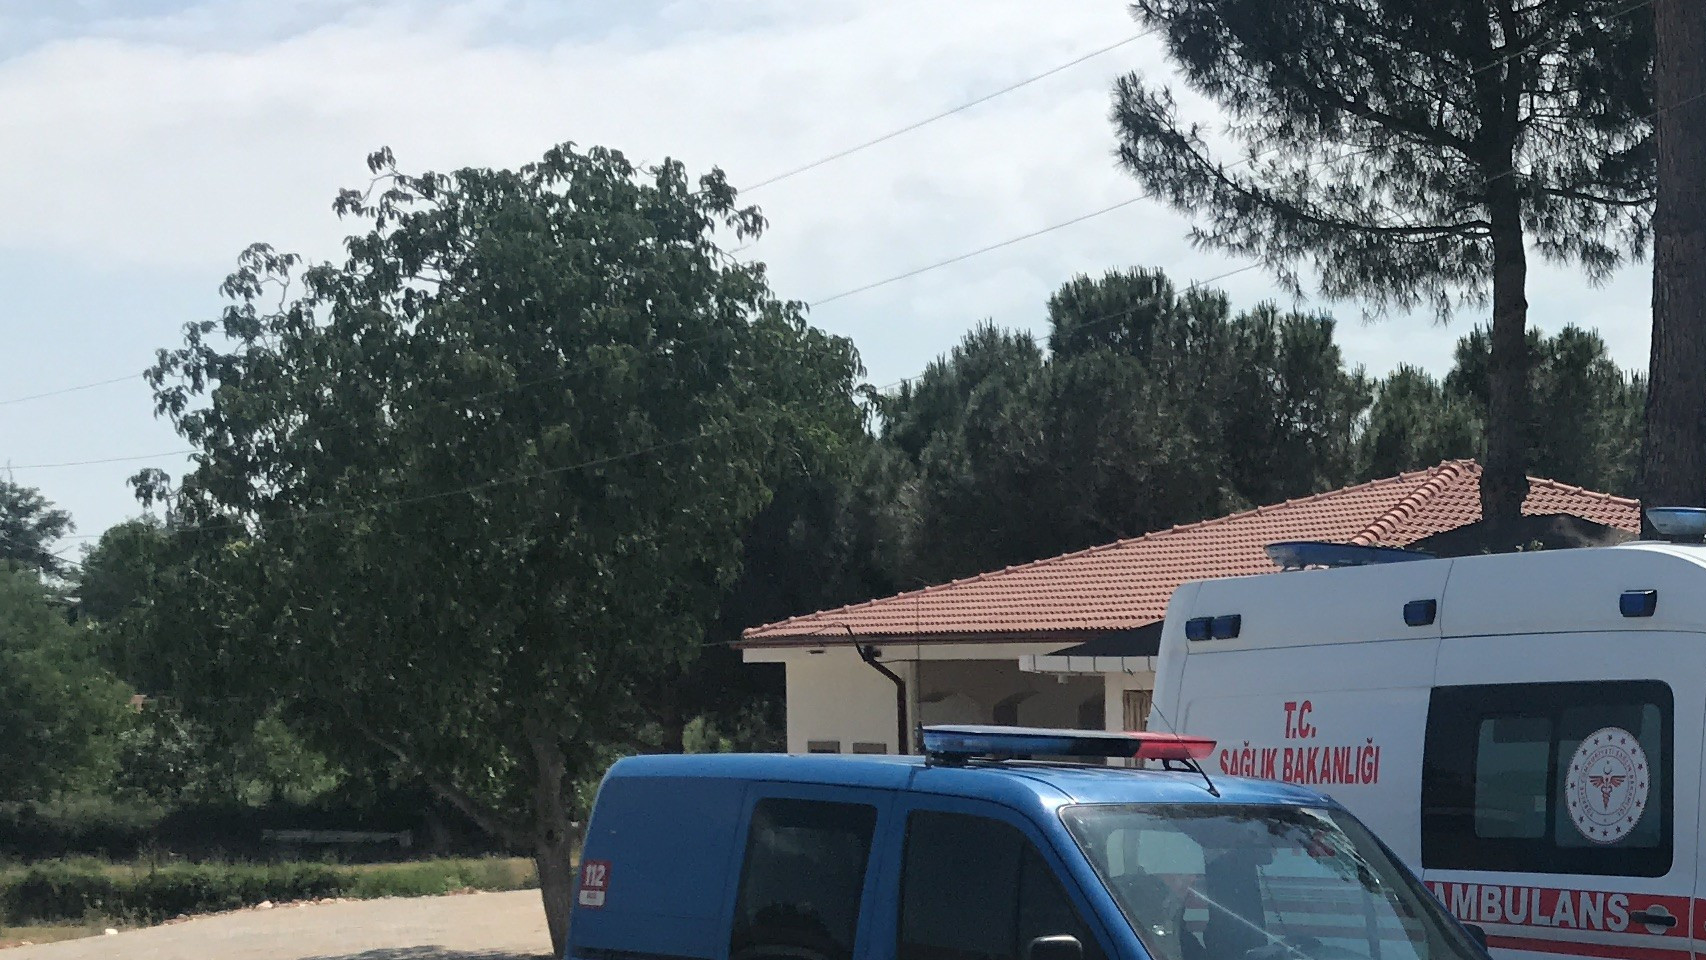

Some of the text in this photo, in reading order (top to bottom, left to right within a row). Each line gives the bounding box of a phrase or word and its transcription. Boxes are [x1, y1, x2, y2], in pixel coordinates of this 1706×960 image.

[1284, 700, 1316, 738] T.C.
[1220, 737, 1380, 784] SAĞLIK BAKANLIĞI
[586, 864, 606, 886] 112
